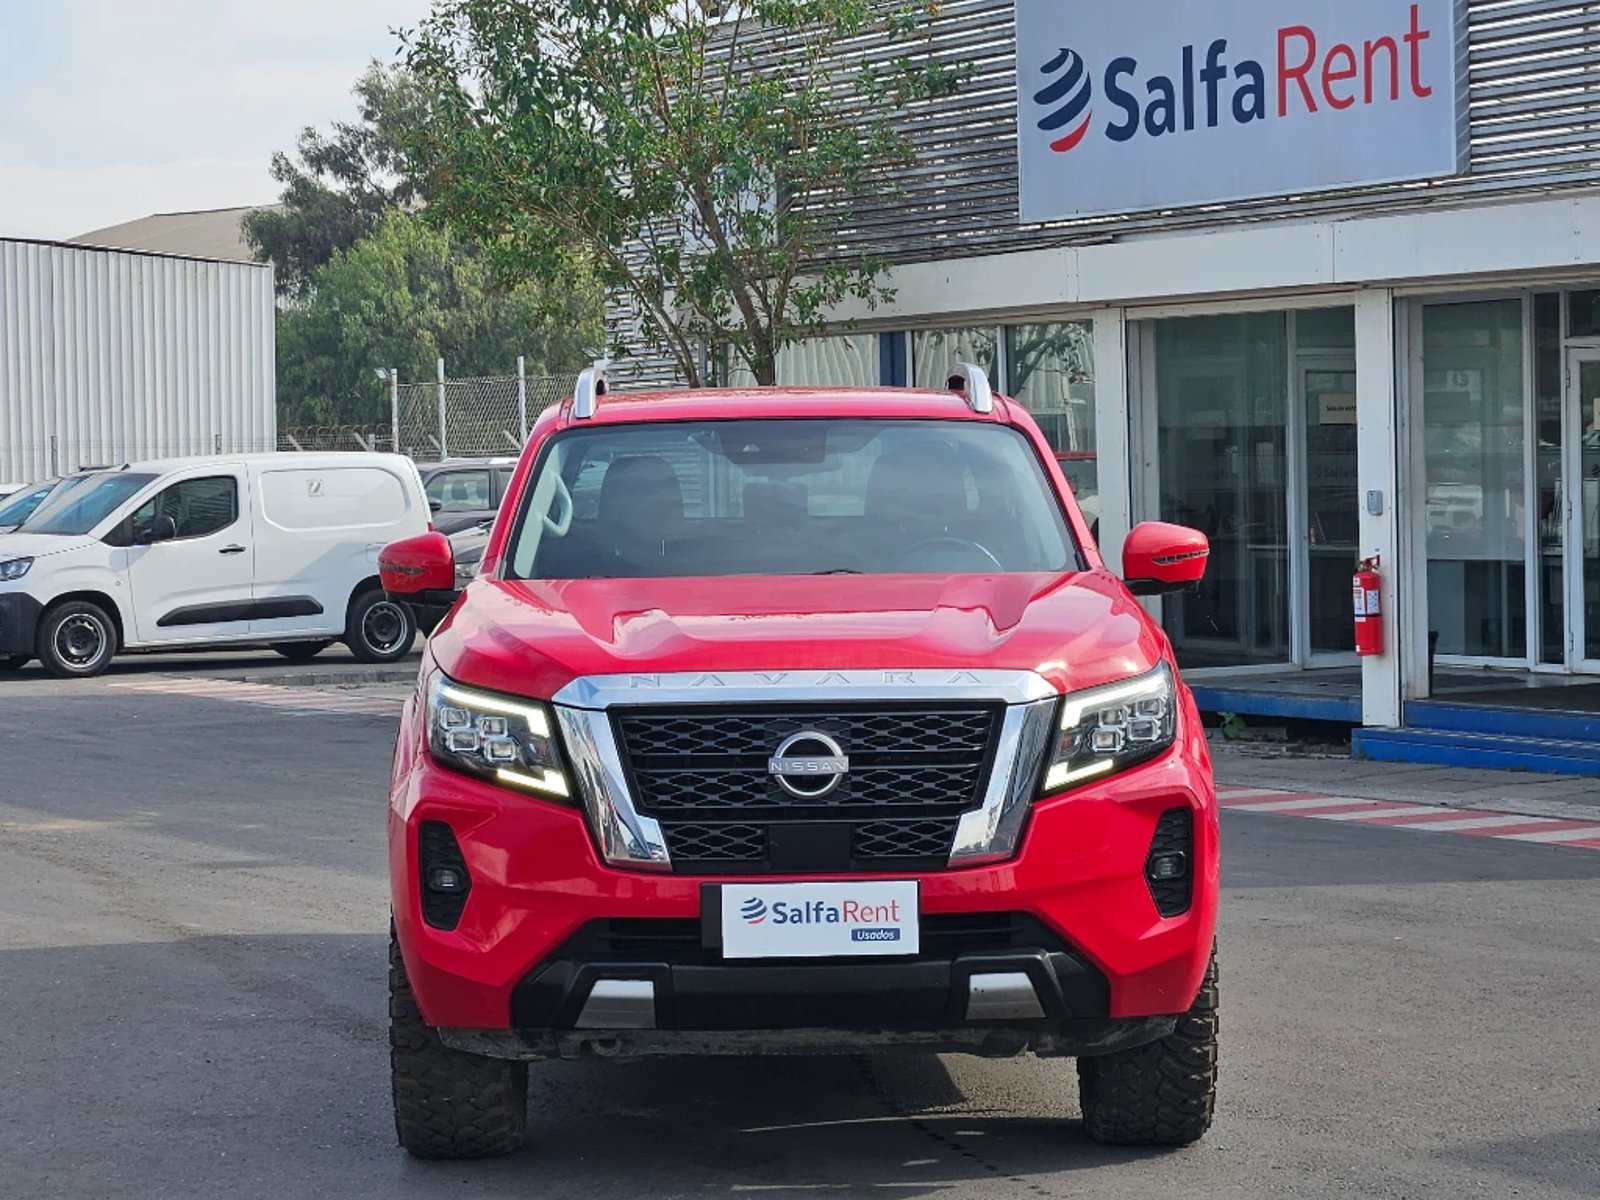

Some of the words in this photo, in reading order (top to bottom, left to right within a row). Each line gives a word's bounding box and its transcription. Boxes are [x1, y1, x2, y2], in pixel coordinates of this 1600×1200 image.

[1103, 3, 1432, 142] SalfaRent
[629, 670, 982, 688] NAVARA
[771, 761, 846, 772] NISSAN
[772, 899, 901, 924] SalfaRent
[856, 930, 895, 941] Usados
